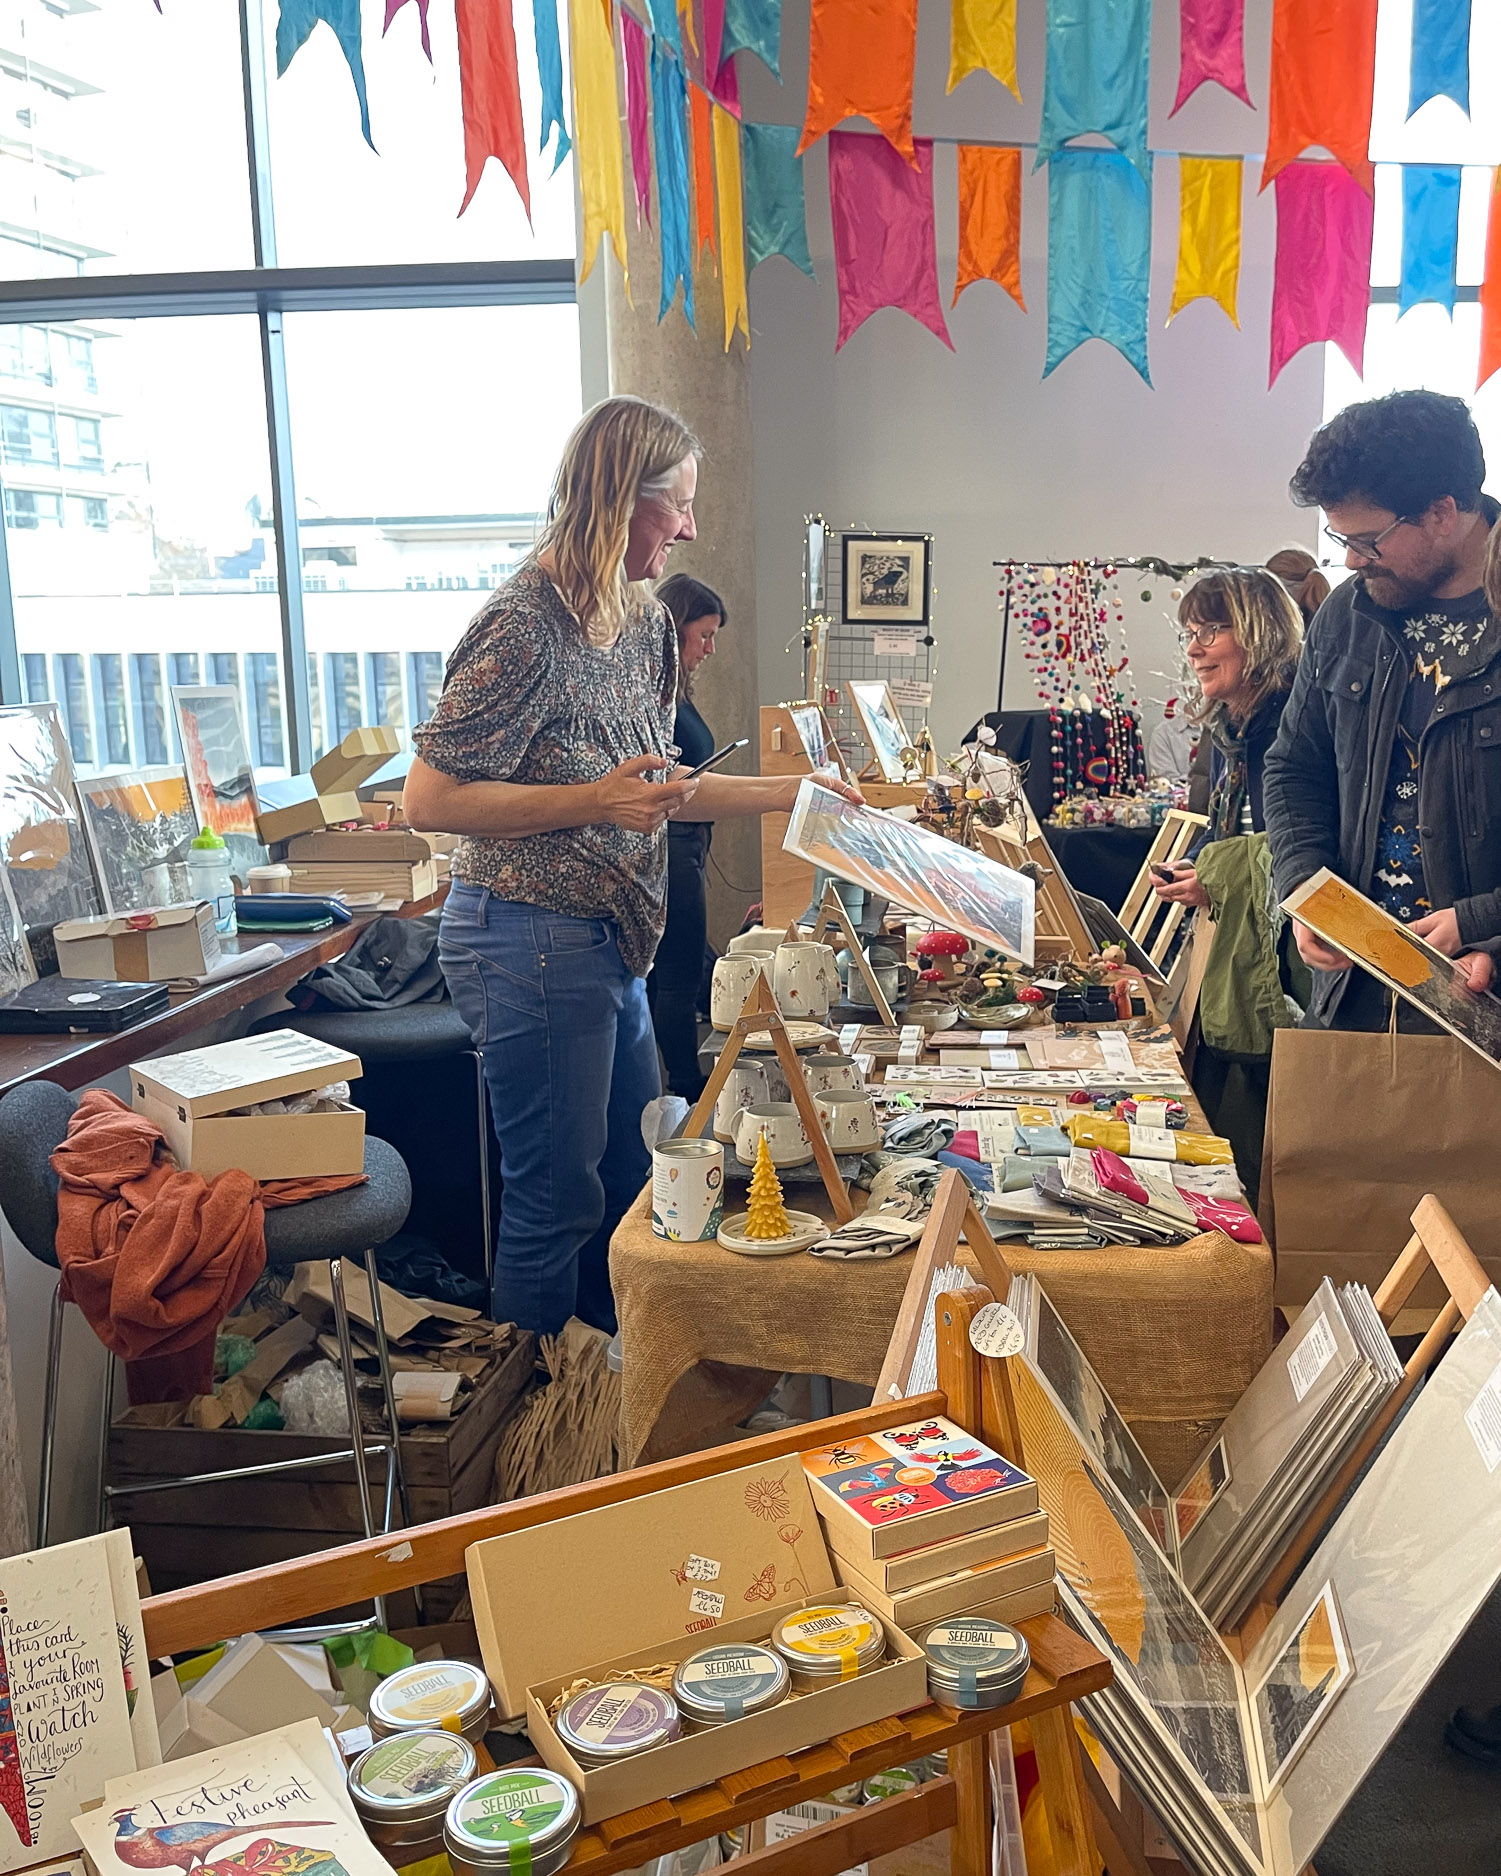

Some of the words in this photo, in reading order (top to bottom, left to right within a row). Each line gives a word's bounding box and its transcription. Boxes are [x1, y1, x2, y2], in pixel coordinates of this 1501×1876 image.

[2, 1615, 50, 1637] Place
[45, 1625, 79, 1648] card
[798, 1615, 846, 1634] SEEDBALL
[948, 1631, 995, 1643] SEEDBALL
[12, 1664, 71, 1700] favourite
[72, 1652, 100, 1681] ROOM
[24, 1643, 84, 1682] your
[705, 1659, 754, 1675] SEEDBALL
[14, 1694, 48, 1716] PLANT
[63, 1677, 104, 1703] SPRING
[400, 1674, 453, 1698] SEEDBALL
[27, 1700, 99, 1744] Watch
[586, 1697, 626, 1729] SEEDBALL
[19, 1737, 84, 1770] Wildflowers
[380, 1747, 433, 1784] SEEDBALL
[147, 1768, 268, 1825] Festive
[226, 1776, 317, 1826] pheasant
[481, 1789, 545, 1815] SEEDBALL
